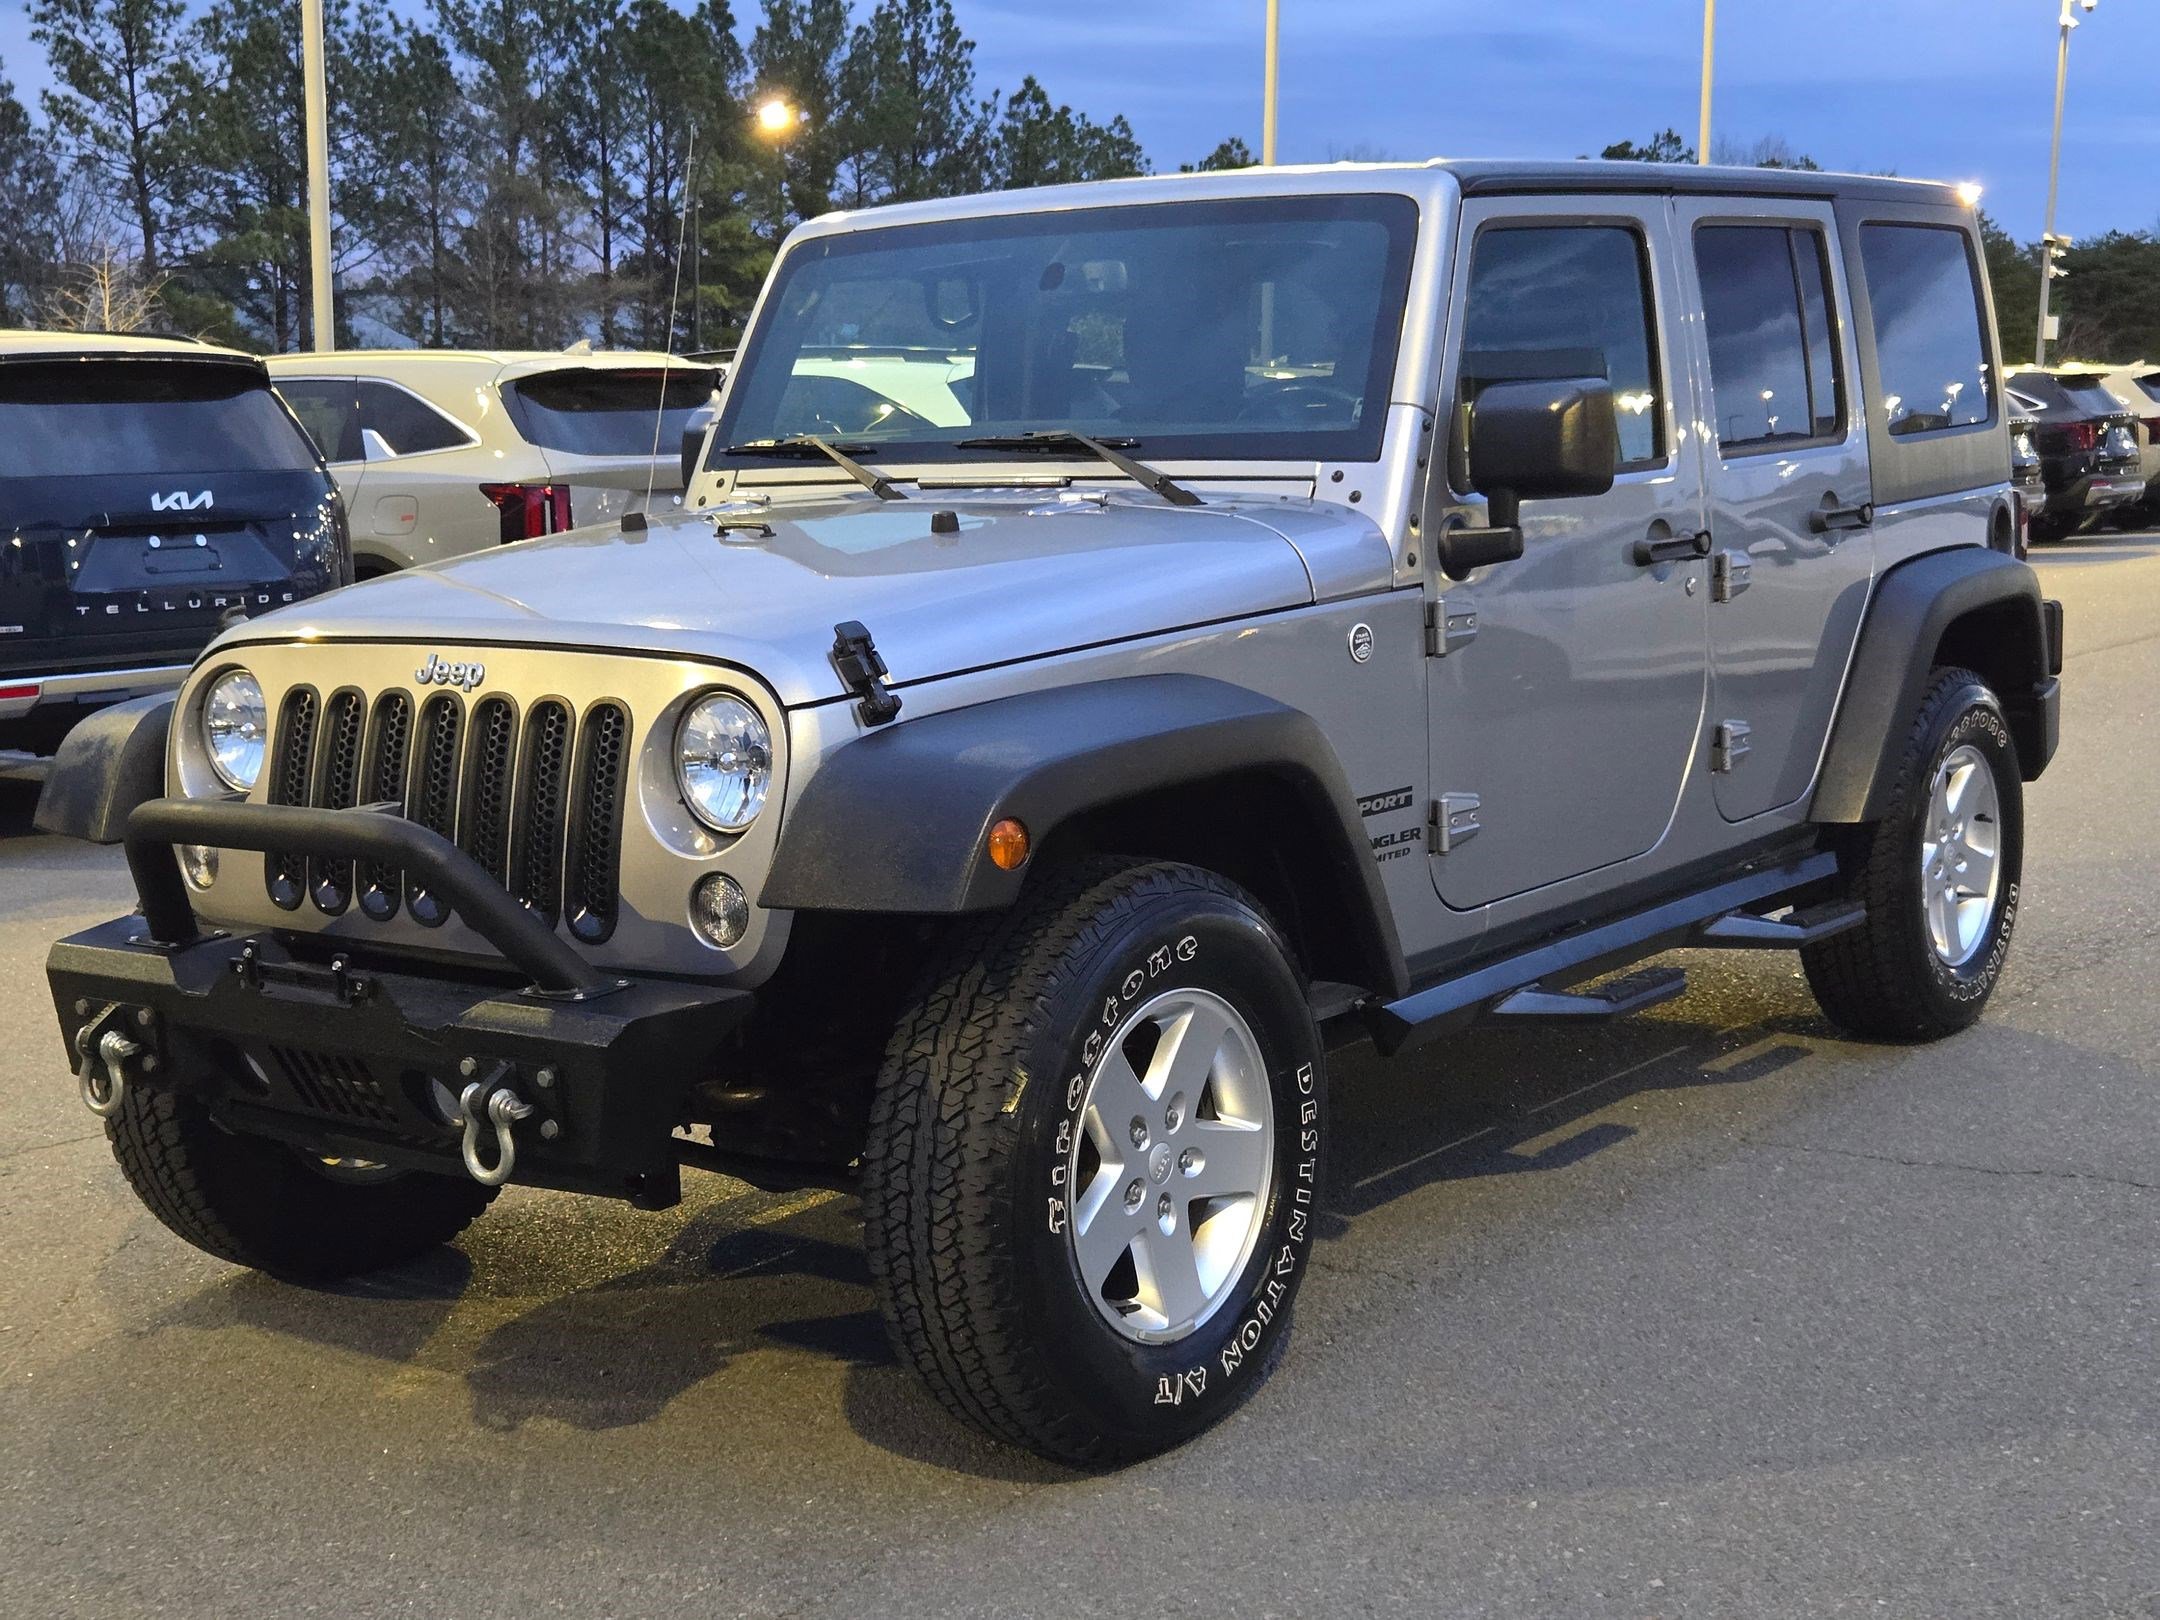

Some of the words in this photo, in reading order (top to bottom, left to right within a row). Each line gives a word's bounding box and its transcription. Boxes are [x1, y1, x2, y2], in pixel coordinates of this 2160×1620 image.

[151, 490, 213, 511] KIA
[76, 593, 293, 615] TELLURIDE
[415, 653, 485, 693] Jeep
[1360, 791, 1412, 812] PORT
[1370, 827, 1421, 850] NGLER
[1221, 1062, 1318, 1376] DESTINATION
[1154, 1366, 1207, 1405] A/T
